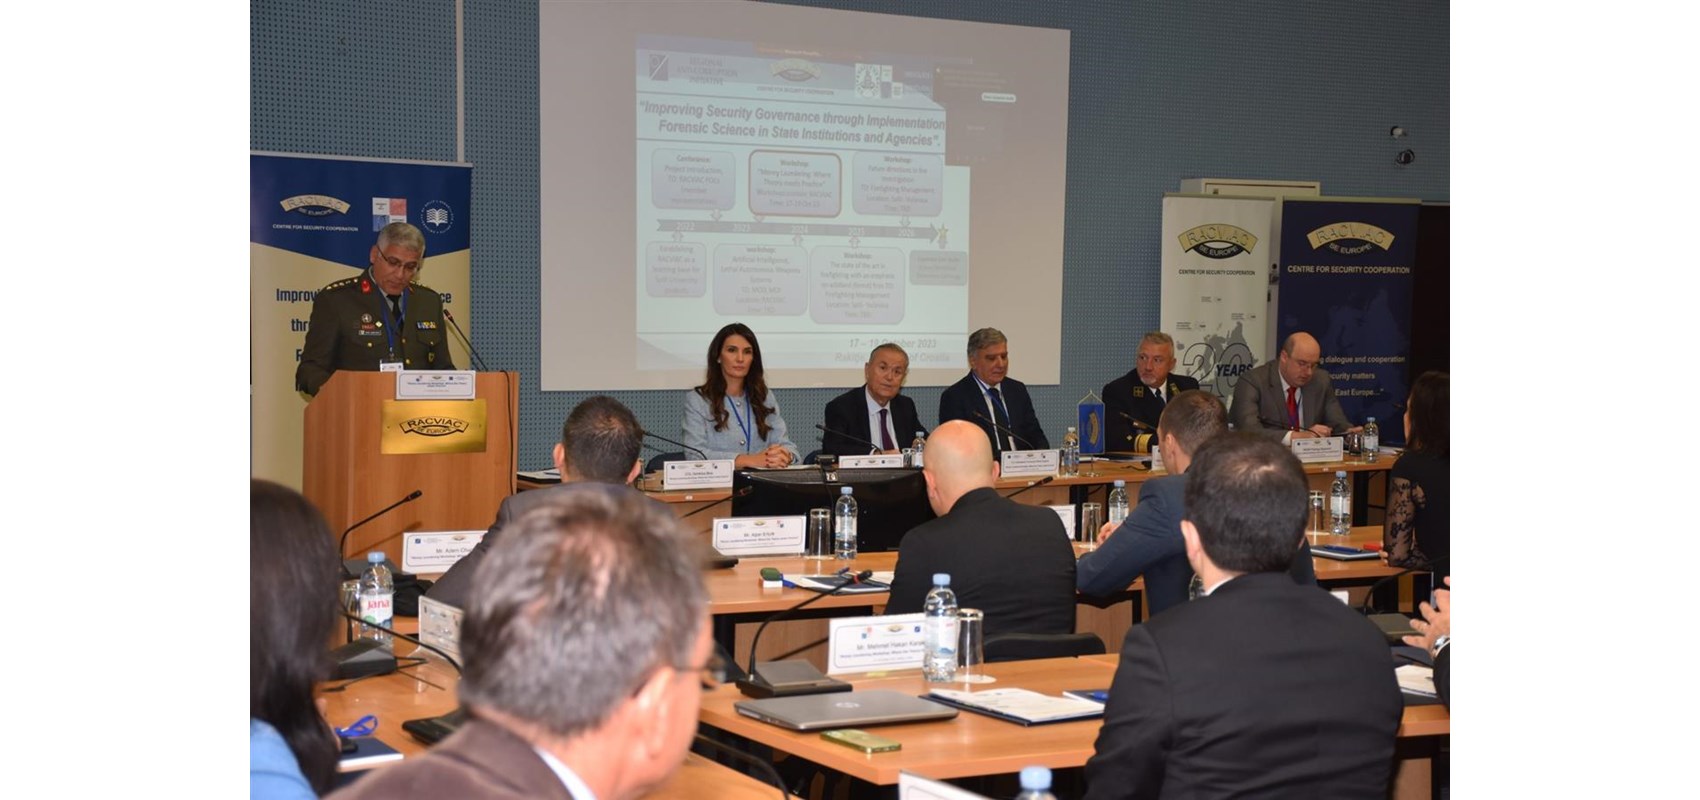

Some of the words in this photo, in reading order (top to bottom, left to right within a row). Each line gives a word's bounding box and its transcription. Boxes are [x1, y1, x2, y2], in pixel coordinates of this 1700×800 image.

[706, 103, 752, 121] Security
[754, 106, 820, 124] Governance
[823, 111, 865, 128] through
[867, 114, 945, 131] Implementation
[658, 119, 709, 135] Forensic
[711, 122, 755, 137] Science
[758, 125, 769, 137] in
[772, 126, 800, 139] State
[802, 128, 861, 142] Institutions
[863, 132, 884, 143] and
[1287, 264, 1315, 274] CENTRE
[1316, 265, 1330, 274] FOR
[1331, 265, 1363, 274] SECURITY
[1363, 266, 1411, 275] COOPERATION
[276, 288, 321, 304] Improv
[1325, 355, 1354, 365] dialogue
[1367, 356, 1406, 365] cooperation
[1351, 372, 1376, 380] matters
[1335, 388, 1350, 397] East
[406, 417, 464, 431] RACVIAC
